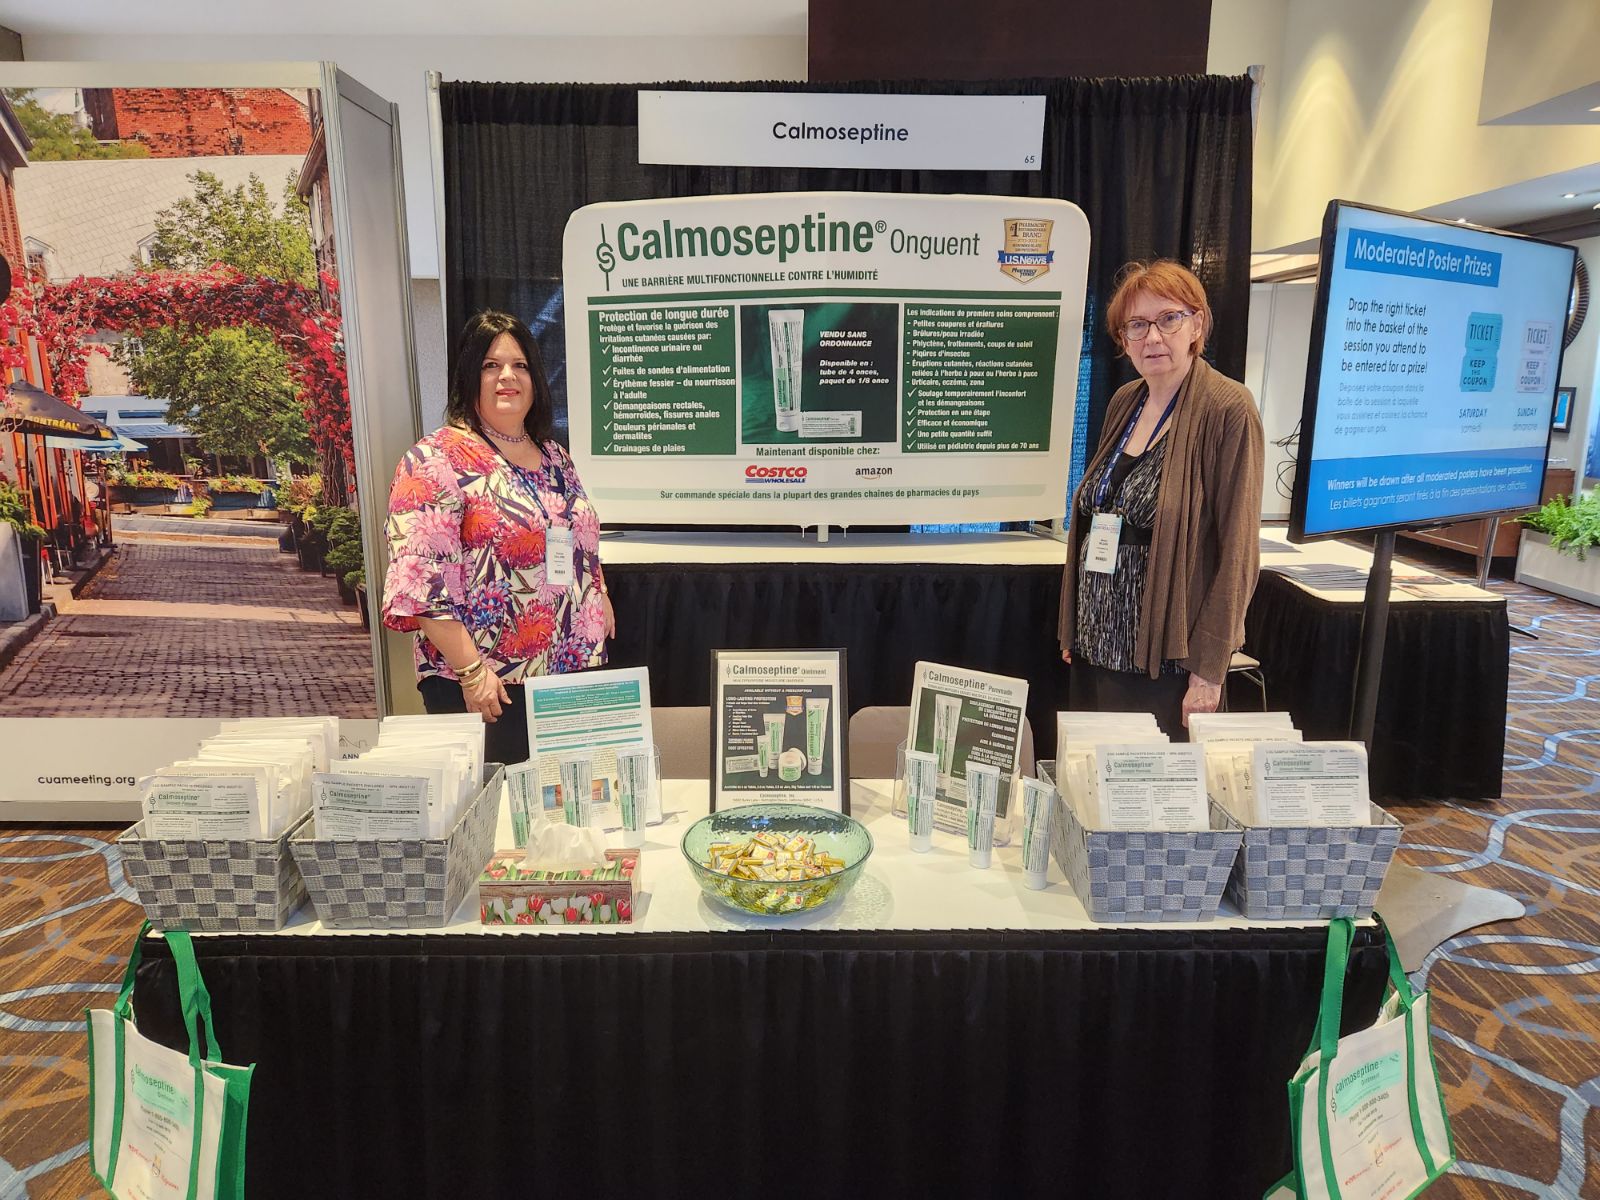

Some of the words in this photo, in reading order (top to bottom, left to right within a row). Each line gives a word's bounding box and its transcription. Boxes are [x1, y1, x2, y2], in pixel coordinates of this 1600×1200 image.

[773, 121, 909, 144] Calmoseptine
[1024, 155, 1035, 164] 65
[890, 228, 980, 260] Onguent
[1354, 237, 1426, 269] Moderated
[1427, 249, 1462, 273] Poster
[1463, 254, 1492, 277] Prizes
[622, 277, 639, 288] UNE
[641, 272, 684, 287] BARRIÈRE
[686, 271, 785, 285] MULTIFONCTIONNELLE
[788, 269, 824, 281] CONTRE
[826, 267, 878, 281] L'HUMIDITÉ
[1348, 297, 1369, 315] Drop
[1370, 299, 1384, 313] the
[1385, 301, 1403, 317] right
[1405, 303, 1427, 317] ticket
[598, 310, 648, 322] Protection
[650, 310, 662, 320] de
[665, 309, 698, 322] longue
[701, 307, 729, 319] durée
[599, 324, 626, 333] Protège
[635, 323, 663, 331] favorise
[665, 322, 672, 330] la
[673, 321, 704, 331] guérison
[705, 321, 718, 329] des
[937, 320, 967, 328] coupures
[968, 320, 975, 328] et
[975, 320, 1004, 329] éraflures
[1345, 317, 1362, 332] into
[1363, 319, 1377, 332] the
[1378, 320, 1406, 335] basket
[1407, 322, 1416, 335] of
[1416, 322, 1428, 335] the
[1470, 323, 1494, 341] TICKET
[1526, 328, 1548, 345] TICKET
[612, 344, 659, 353] Incontinence
[661, 343, 691, 352] urinaire
[1007, 340, 1015, 348] de
[1016, 340, 1033, 348] soleil
[1343, 338, 1373, 352] session
[1375, 343, 1391, 355] you
[1392, 341, 1417, 354] attend
[1419, 342, 1427, 355] to
[612, 354, 644, 363] diarrhée
[943, 360, 974, 368] cutanées,
[975, 360, 1004, 368] réactions
[1005, 360, 1033, 368] cutanées
[1341, 358, 1353, 372] be
[1355, 359, 1387, 372] entered
[1388, 360, 1399, 373] for
[1400, 363, 1406, 373] a
[1407, 361, 1428, 376] prize!
[1469, 360, 1486, 368] KEEP
[1526, 361, 1540, 370] KEEP
[612, 366, 635, 375] Fuites
[636, 366, 646, 375] de
[647, 366, 674, 375] sondes
[676, 365, 731, 374] d'alimentation
[1462, 376, 1488, 386] COUPON
[1520, 376, 1541, 385] COUPON
[613, 401, 671, 411] Démangeaisons
[672, 401, 705, 410] rectales,
[936, 399, 985, 407] démangeaisons
[663, 410, 693, 418] fissures
[695, 410, 720, 418] anales
[1458, 408, 1488, 419] SATURDAY
[1517, 407, 1538, 417] SUNDAY
[613, 423, 646, 431] Douleurs
[647, 422, 687, 432] périanales
[951, 419, 988, 427] économique
[613, 432, 653, 440] dermatites
[917, 430, 929, 438] Une
[931, 430, 949, 438] petite
[950, 429, 975, 438] quantité
[613, 444, 650, 453] Drainages
[652, 444, 662, 452] de
[663, 443, 686, 453] plaies
[917, 442, 937, 450] Utilisé
[947, 442, 974, 450] pédiatrie
[975, 442, 995, 450] depuis
[996, 442, 1009, 450] plus
[756, 446, 806, 457] Maintenant
[808, 446, 855, 457] disponible
[857, 446, 880, 456] chez:
[745, 465, 808, 478] COSTCO
[855, 466, 893, 477] amazon
[1327, 479, 1355, 491] Winners
[1356, 476, 1368, 488] will
[1368, 477, 1378, 487] be
[1379, 475, 1400, 487] drawn
[1400, 473, 1416, 485] after
[1416, 472, 1425, 484] all
[1425, 471, 1458, 481] moderated
[1458, 469, 1479, 480] posters
[1479, 468, 1493, 478] have
[1493, 467, 1507, 476] been
[660, 490, 673, 500] Sur
[674, 490, 716, 500] commande
[718, 490, 751, 501] spéciale
[752, 490, 771, 499] dans
[773, 490, 781, 499] la
[783, 489, 812, 500] plupart
[814, 489, 828, 499] des
[830, 489, 862, 500] grandes
[864, 488, 894, 498] chaînes
[895, 488, 905, 498] de
[907, 488, 950, 499] pharmacies
[951, 488, 961, 498] du
[963, 488, 980, 499] pays
[37, 773, 136, 787] cuameeting.org
